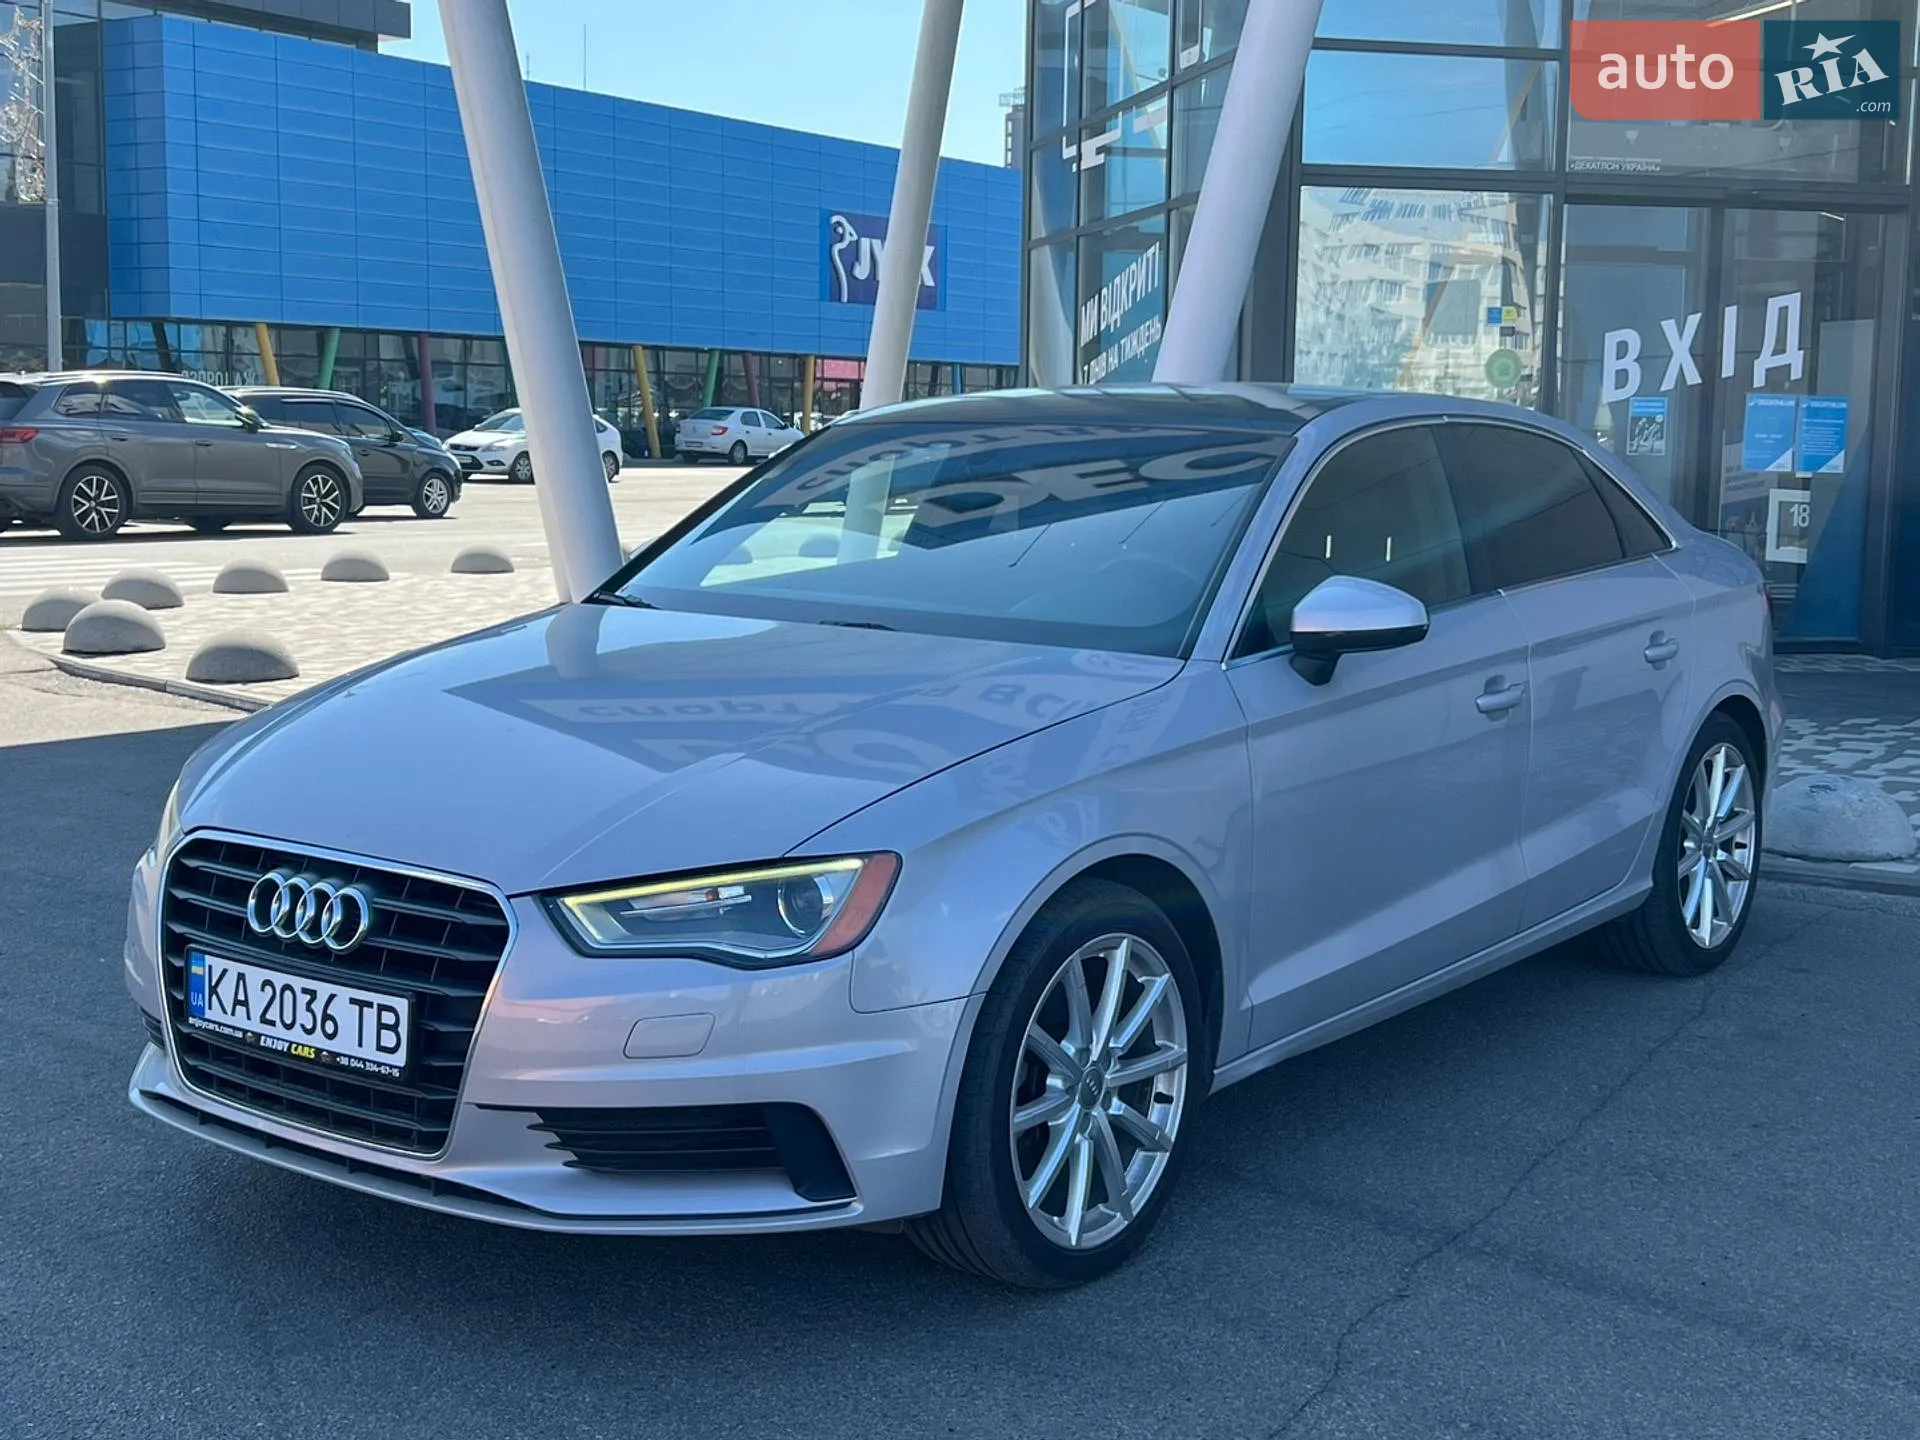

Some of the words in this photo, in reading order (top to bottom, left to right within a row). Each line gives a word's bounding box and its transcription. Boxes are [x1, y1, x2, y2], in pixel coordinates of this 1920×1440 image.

[1080, 293, 1099, 348] МИ
[1100, 240, 1160, 334] ВІДКРИТІ
[1601, 291, 1805, 404] ВХІД
[1789, 503, 1810, 528] 18
[190, 992, 204, 1007] UA
[207, 964, 252, 1021] KA
[259, 978, 339, 1041] 2036
[348, 996, 401, 1055] TB
[259, 1035, 290, 1053] ENJOY
[290, 1045, 316, 1060] CARS
